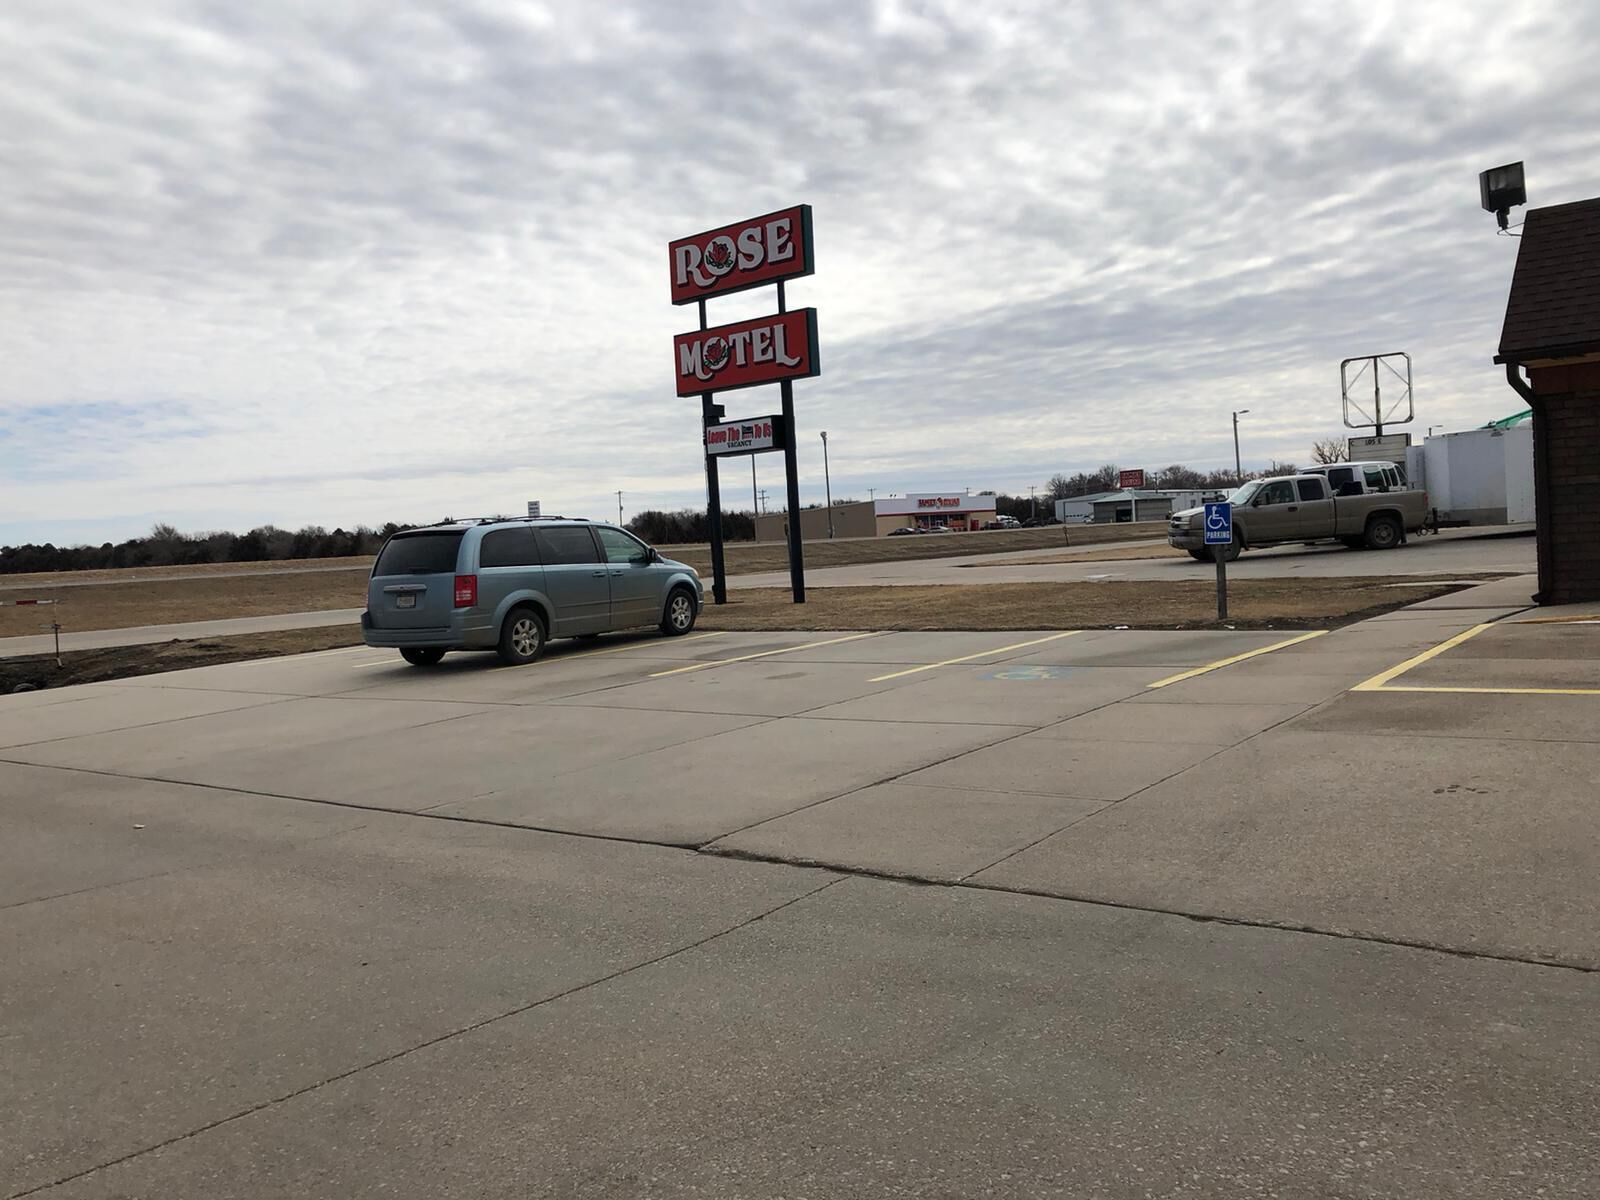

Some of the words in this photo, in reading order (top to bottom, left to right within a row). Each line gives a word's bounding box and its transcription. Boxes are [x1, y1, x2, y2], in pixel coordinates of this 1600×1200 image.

[675, 218, 793, 287] ROSE
[679, 323, 801, 380] MOTEL
[727, 427, 740, 441] The
[754, 424, 762, 438] To
[727, 440, 752, 448] VACANCY
[1207, 531, 1230, 539] PARKING
